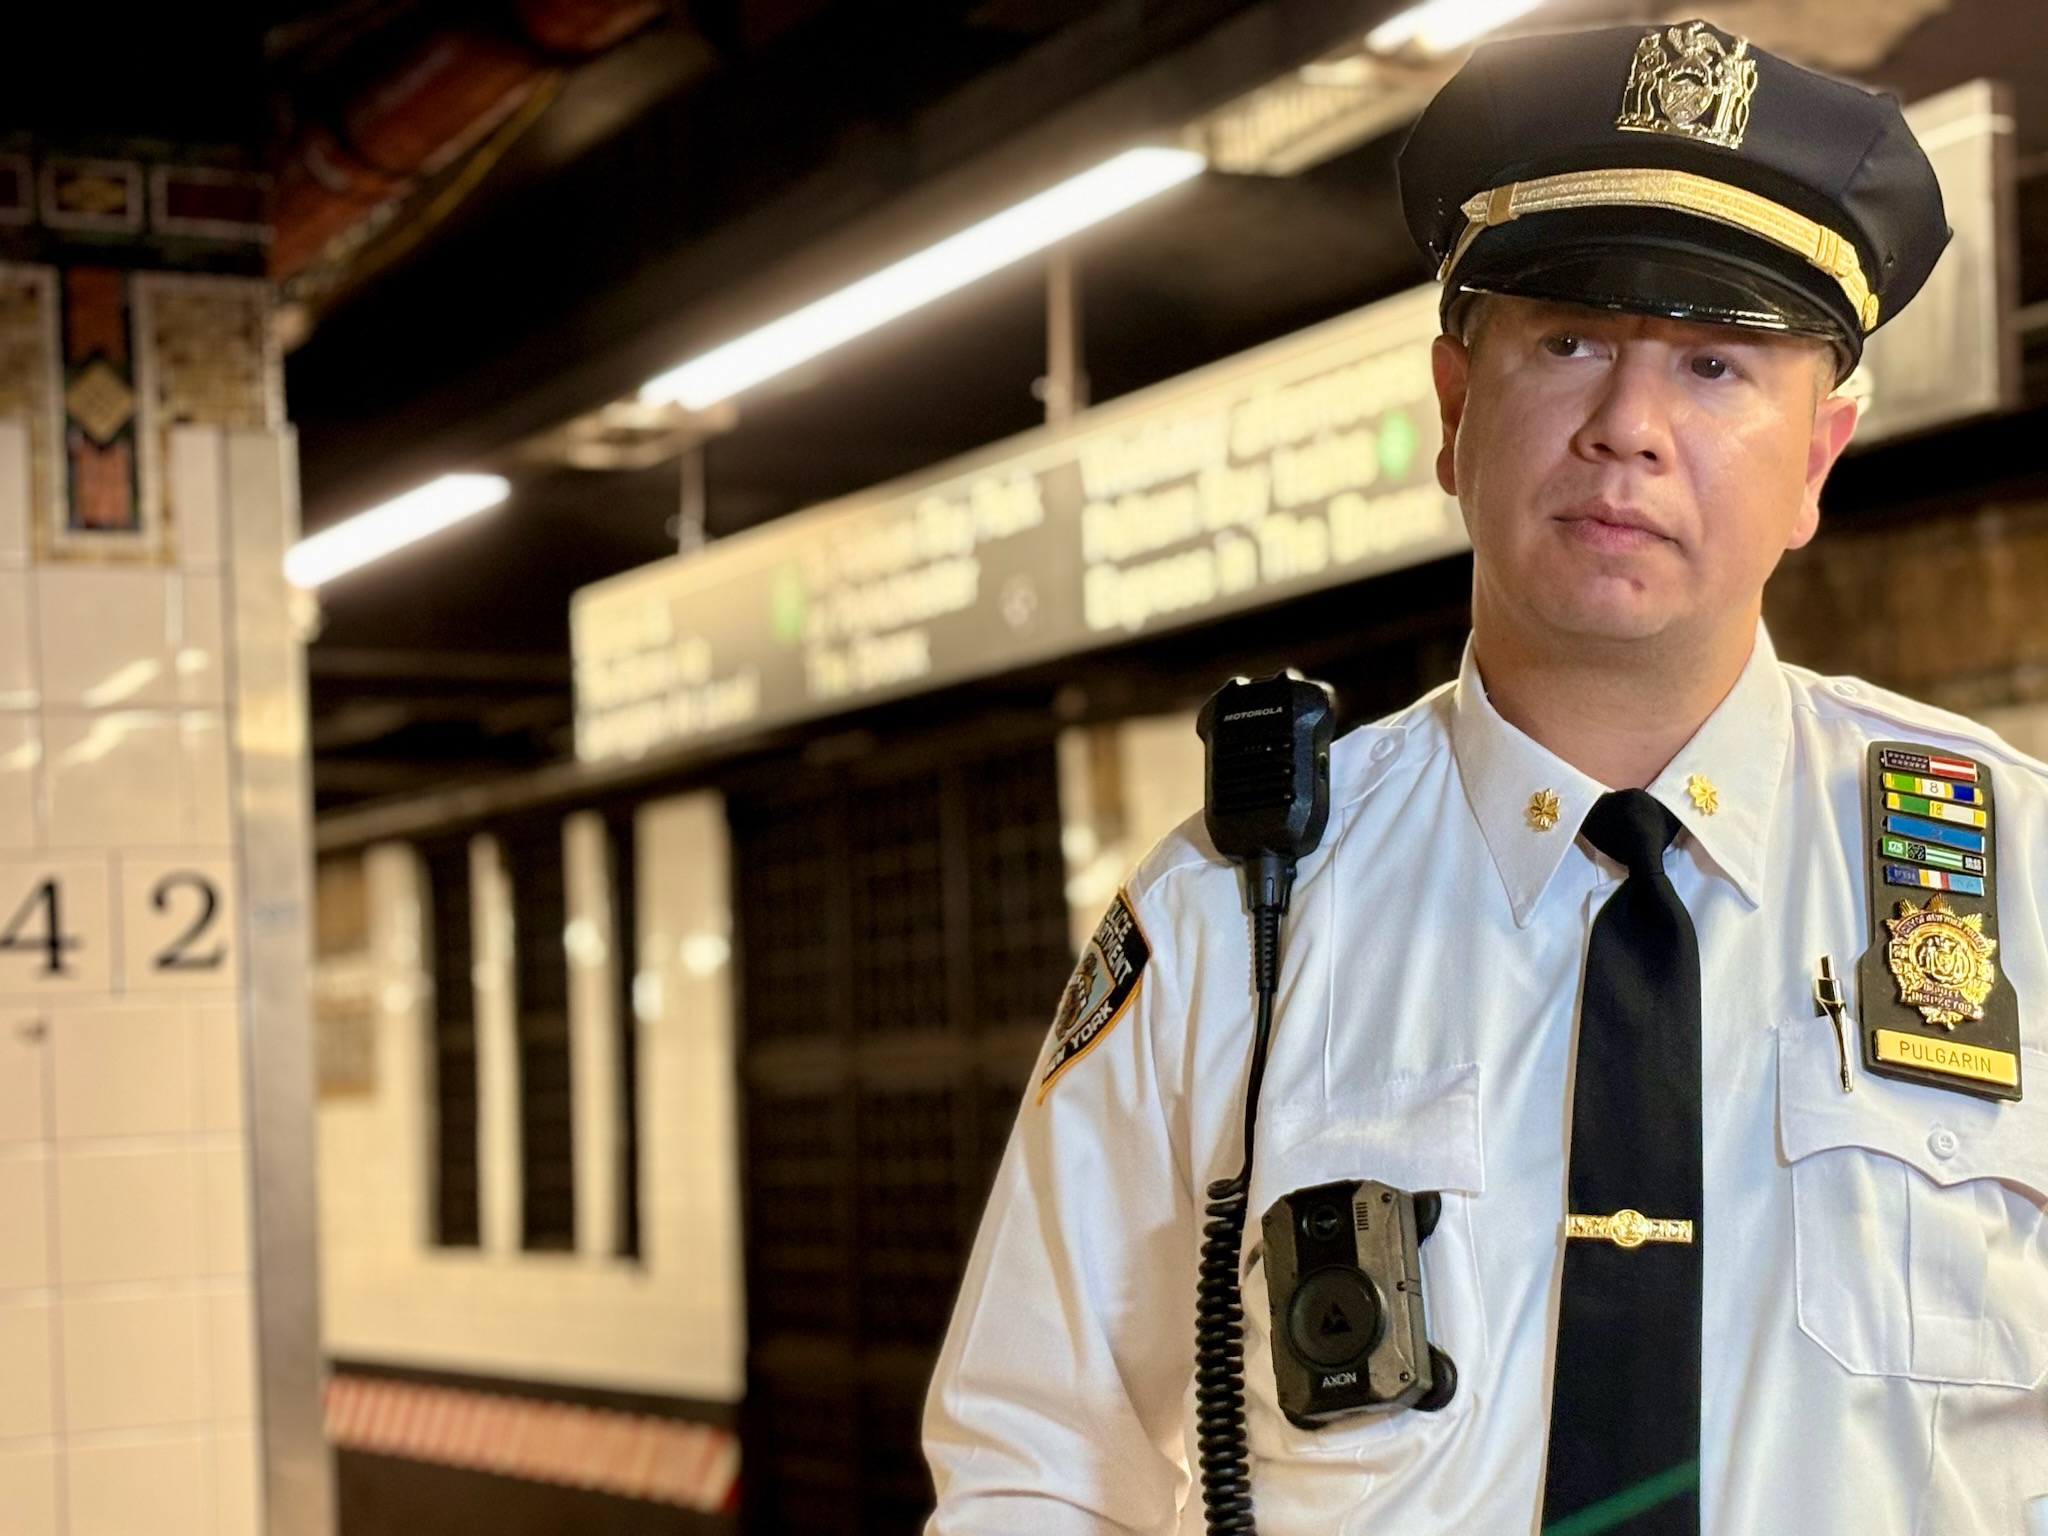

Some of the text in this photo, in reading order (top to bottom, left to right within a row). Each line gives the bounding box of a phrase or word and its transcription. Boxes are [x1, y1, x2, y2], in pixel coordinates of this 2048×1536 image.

[1223, 706, 1283, 721] MOTOROLA
[1930, 782, 1938, 794] 8
[1930, 803, 1942, 816] 18
[1070, 1000, 1114, 1050] YORK
[1899, 1040, 1992, 1074] PULGARIN
[1322, 1371, 1358, 1388] AXON
